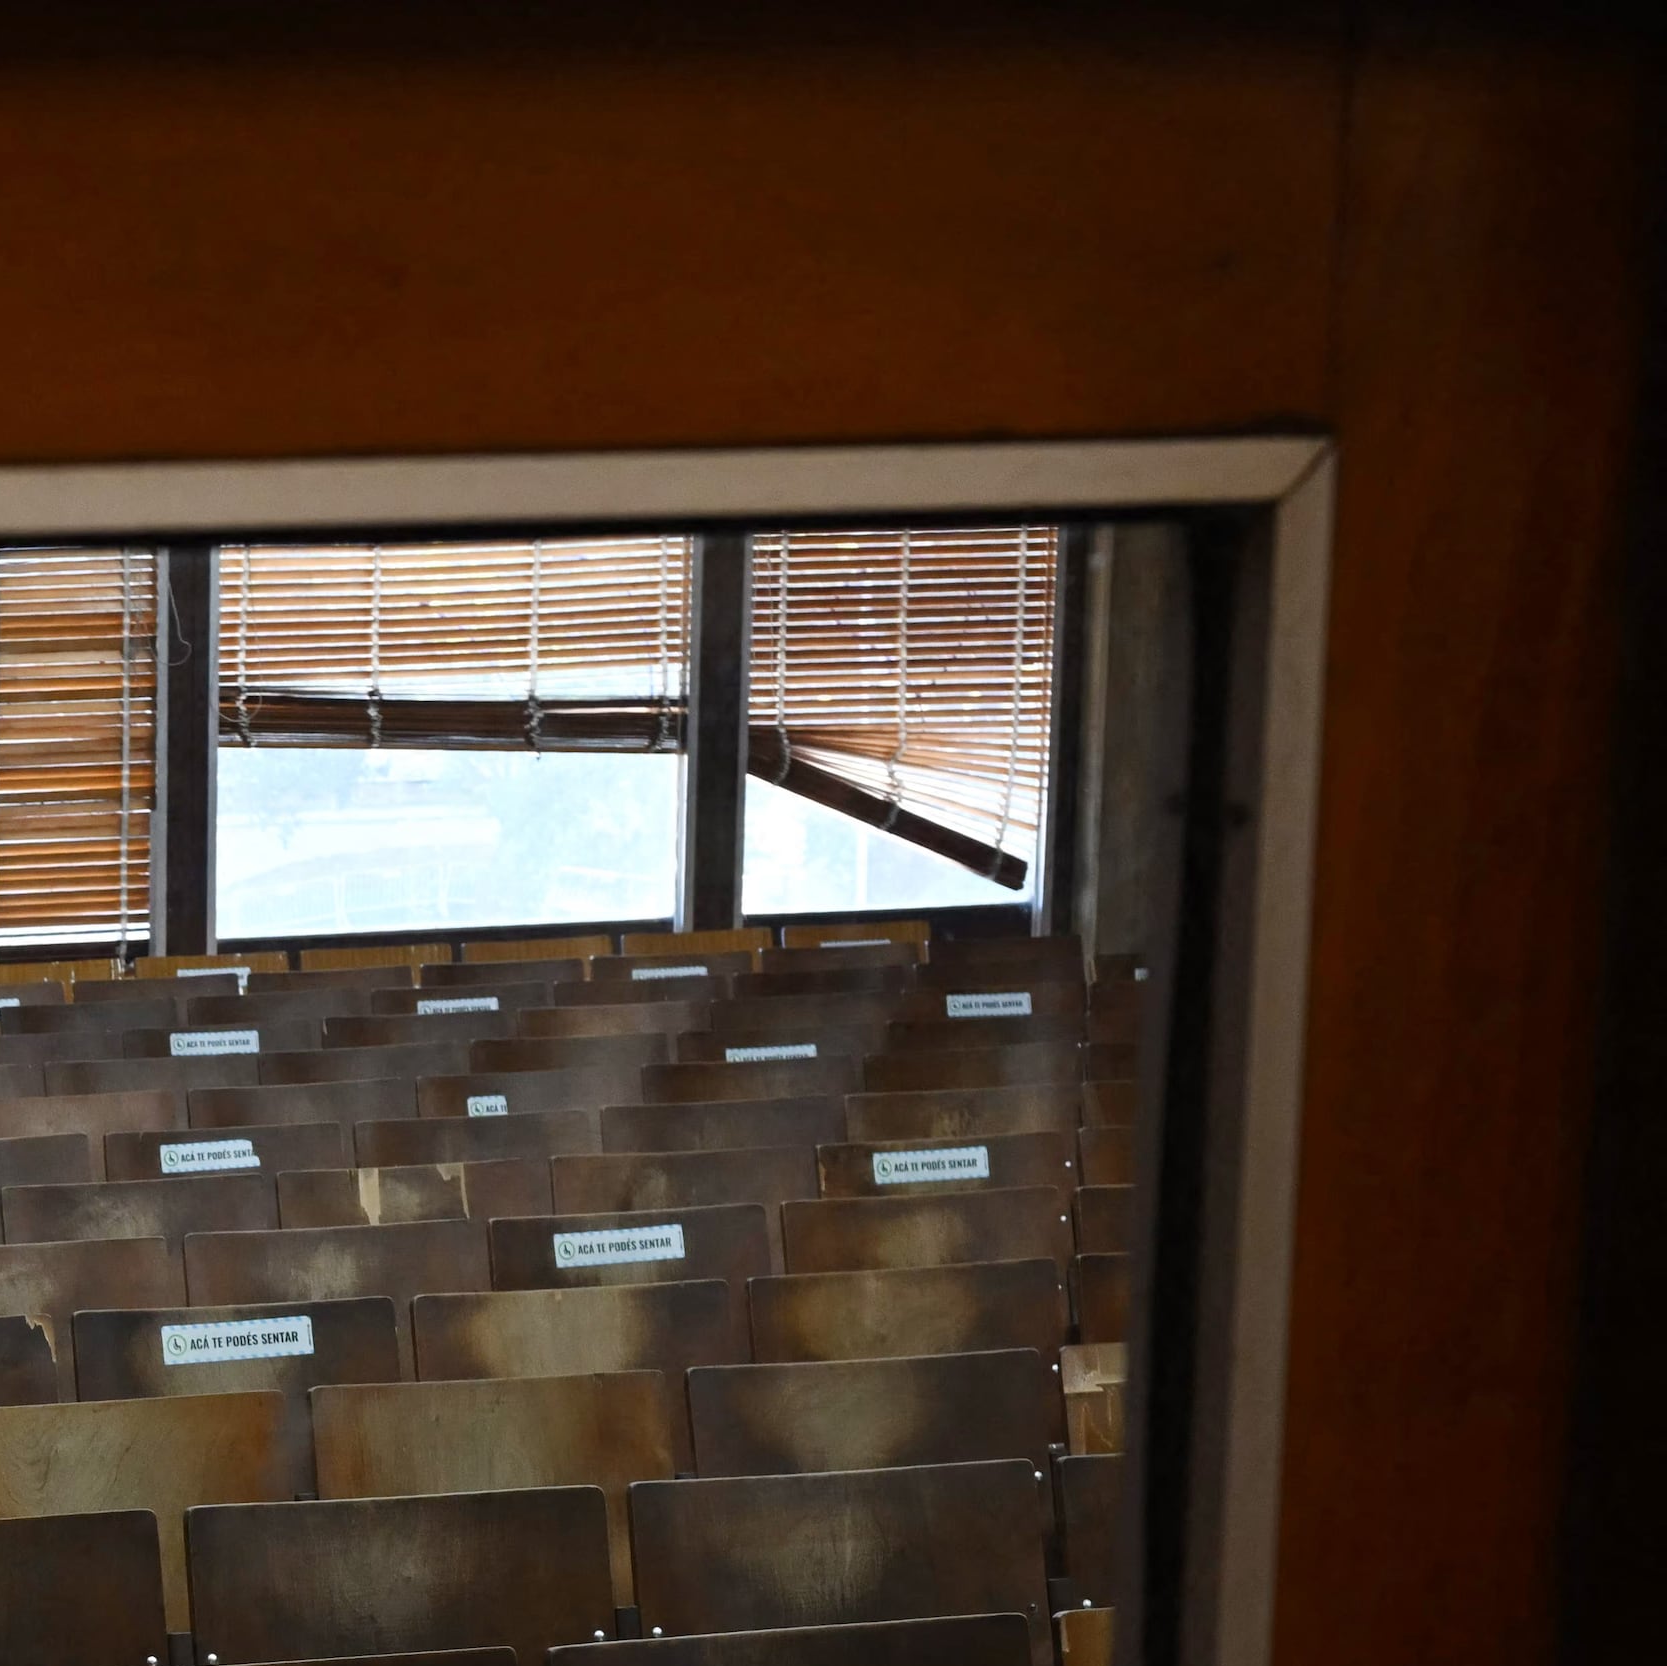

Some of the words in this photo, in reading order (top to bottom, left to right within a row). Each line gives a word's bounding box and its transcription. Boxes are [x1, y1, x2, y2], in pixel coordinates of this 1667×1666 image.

[181, 1151, 195, 1162] ACÁ
[197, 1152, 205, 1161] TE
[207, 1149, 231, 1161] PODÉS
[895, 1160, 909, 1172] ACÁ
[911, 1162, 919, 1171] TE
[921, 1158, 946, 1171] PODÉS
[948, 1158, 978, 1169] SENTAR
[578, 1241, 595, 1255] ACÁ
[597, 1243, 606, 1253] TE
[608, 1238, 637, 1253] PODÉS
[639, 1237, 672, 1250] SENTAR
[190, 1334, 210, 1350] ACÁ
[212, 1336, 223, 1349] TE
[225, 1331, 259, 1347] PODÉS
[261, 1331, 299, 1345] SENTAR
